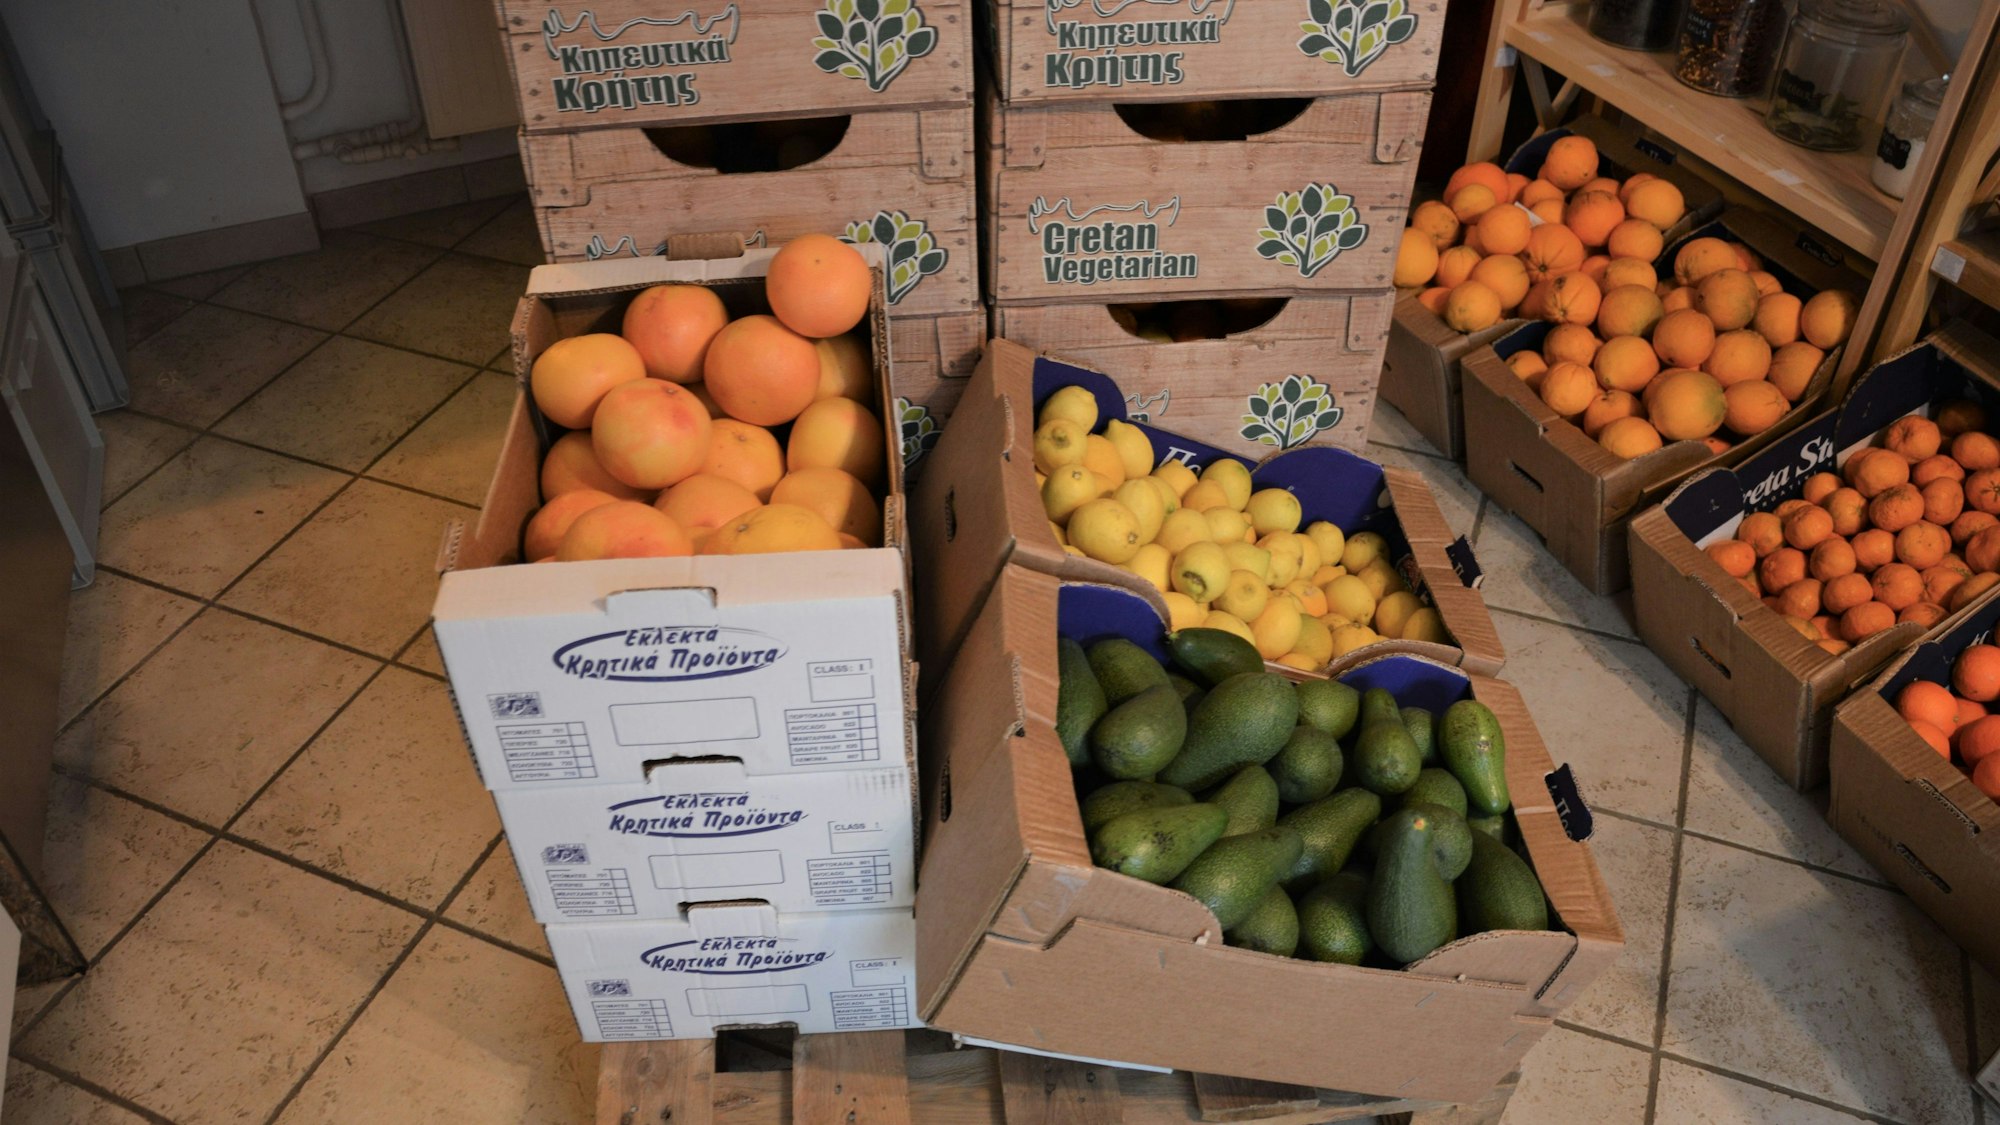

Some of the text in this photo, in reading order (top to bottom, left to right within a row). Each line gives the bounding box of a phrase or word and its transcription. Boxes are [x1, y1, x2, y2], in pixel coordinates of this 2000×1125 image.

[1058, 15, 1220, 50] Κηπευτικά
[561, 33, 729, 74] Κηπευτικά
[1045, 50, 1184, 87] Κρήτης
[553, 72, 700, 112] Κρήτης
[1043, 222, 1157, 255] Cretan
[1043, 251, 1197, 285] Vegetarian
[624, 626, 719, 647] Εκλεκτά
[563, 644, 779, 679] Κρητικά Προϊόντα
[663, 792, 748, 810] Εκλεκτά
[609, 808, 803, 834] Κρητικά Προϊόντα
[700, 937, 777, 951] Εκλεκτά
[650, 950, 827, 972] Κρητικά Προϊόντα
